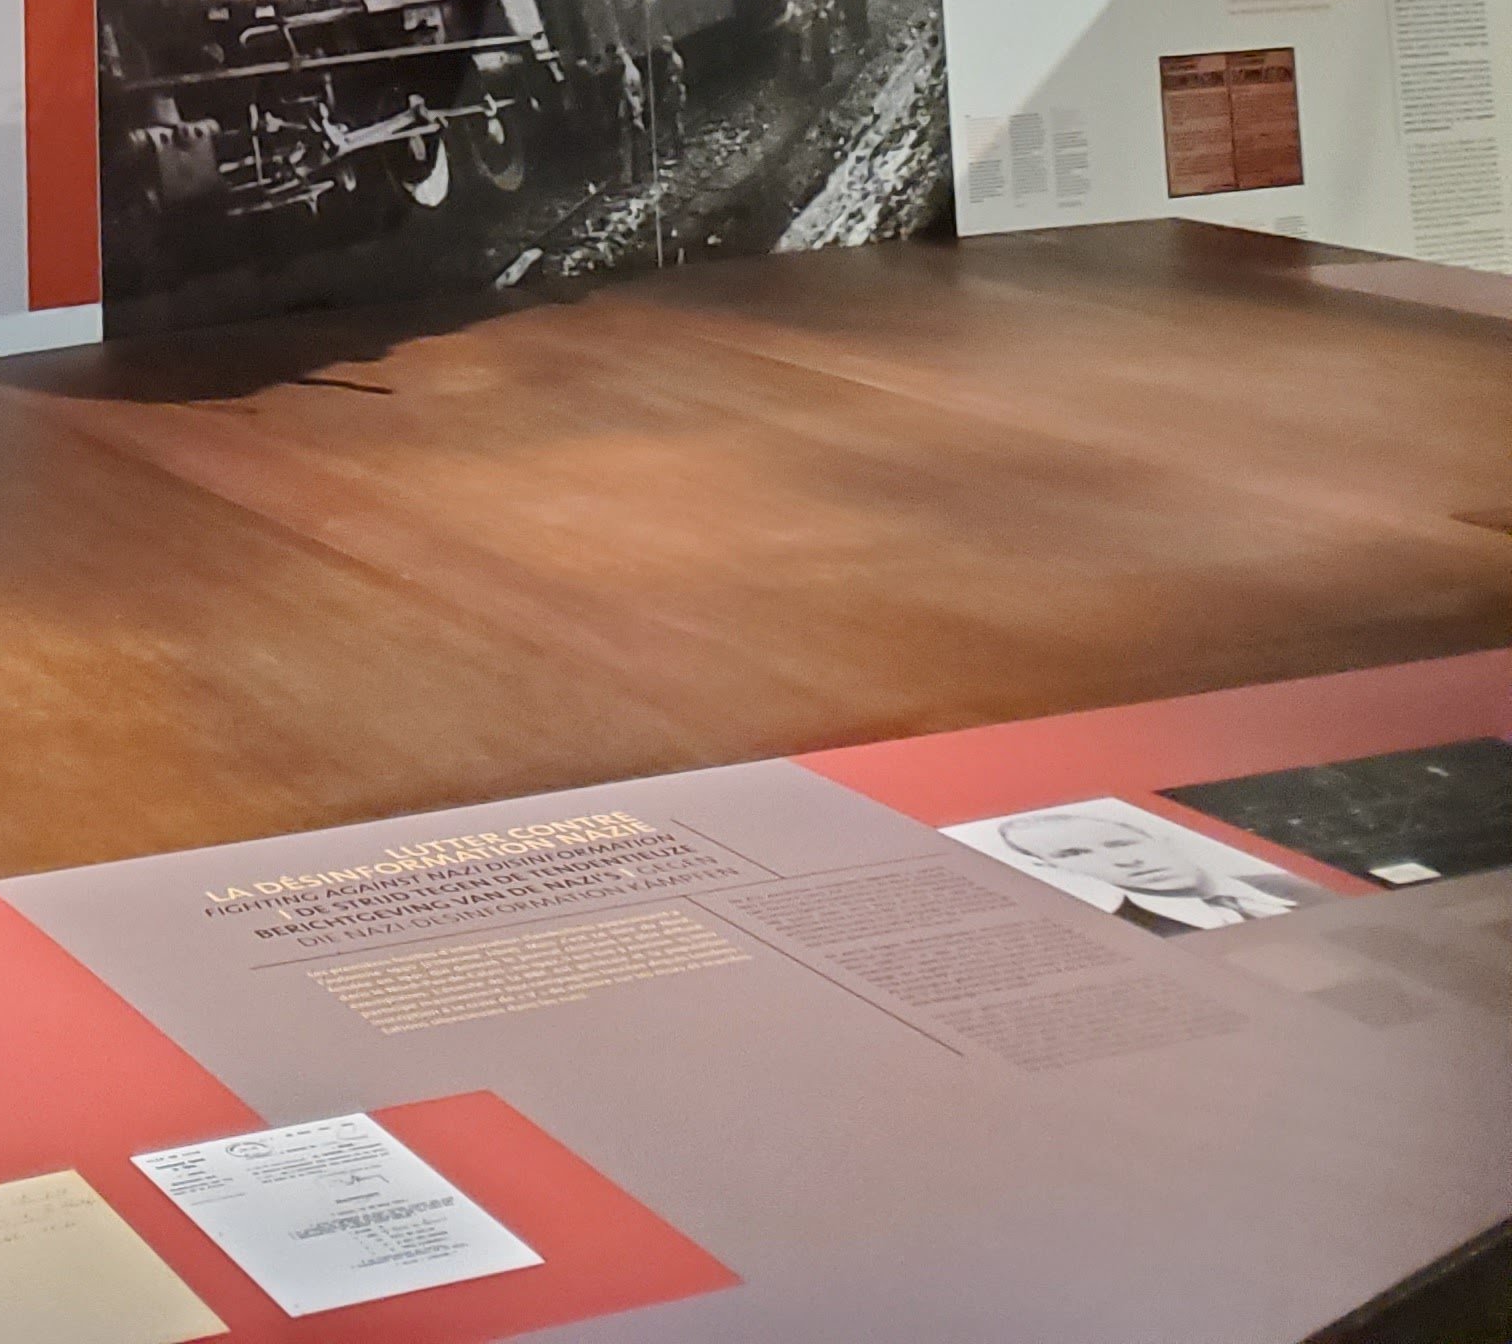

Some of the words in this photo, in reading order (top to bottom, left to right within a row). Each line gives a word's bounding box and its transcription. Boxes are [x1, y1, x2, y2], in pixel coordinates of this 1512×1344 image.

[205, 887, 253, 903] LA
[253, 838, 556, 895] DÉSINFORMATION
[555, 820, 658, 845] NAZIE
[384, 831, 502, 860] LUTTER
[507, 811, 638, 840] CONTRE
[203, 891, 319, 918] FIGHTING
[325, 874, 420, 900] AGAINST
[427, 864, 482, 882] NAZI
[484, 833, 676, 872] DISINFORMATION
[253, 900, 451, 940] BERICHTGEVING
[449, 890, 507, 906] VAN
[506, 884, 542, 897] DE
[543, 871, 623, 891] NAZI'S
[295, 905, 330, 917] DE
[410, 877, 493, 899] TEGEN
[488, 872, 528, 885] DE
[529, 843, 698, 880] TENDENTIEUZE
[297, 933, 338, 948] DIE
